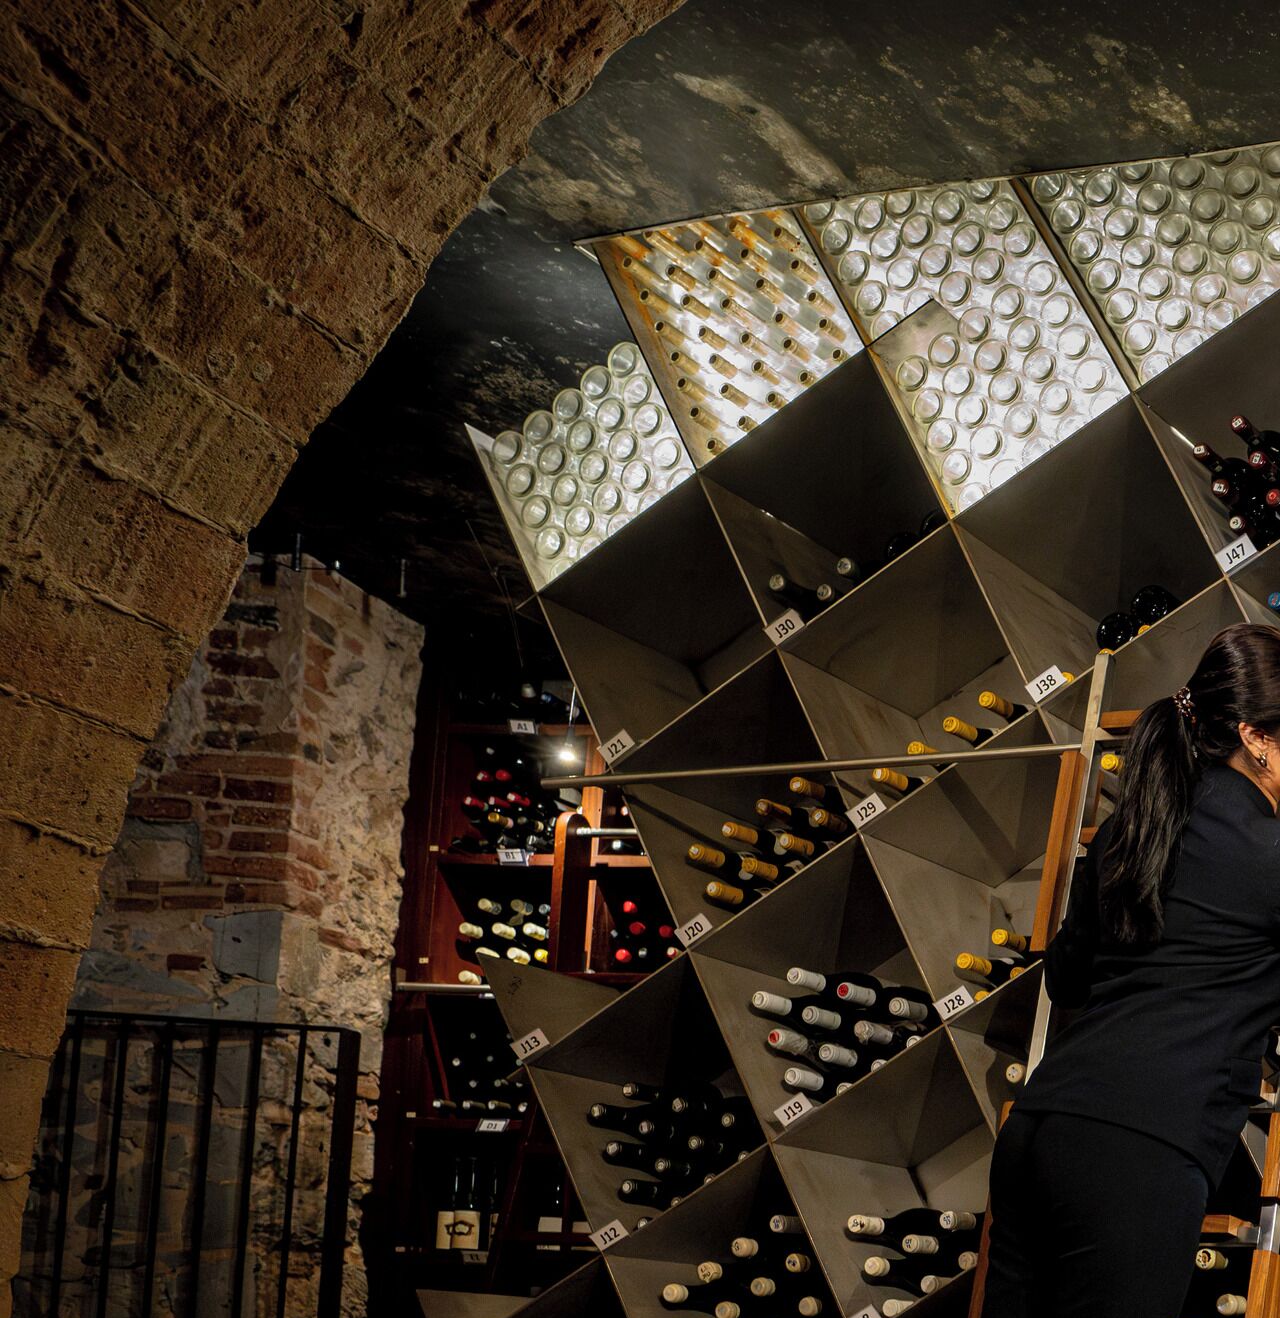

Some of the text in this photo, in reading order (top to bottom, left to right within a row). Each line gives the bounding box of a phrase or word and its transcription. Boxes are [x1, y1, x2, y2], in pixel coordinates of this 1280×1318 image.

[1226, 543, 1245, 564] J47
[775, 619, 795, 639] J30
[1036, 674, 1056, 695] J38
[607, 739, 627, 758] J21
[856, 802, 876, 821] J29
[684, 921, 703, 941] J20
[944, 994, 965, 1013] J28
[520, 1036, 540, 1054] J13
[783, 1101, 803, 1120] J19
[600, 1227, 620, 1245] J12
